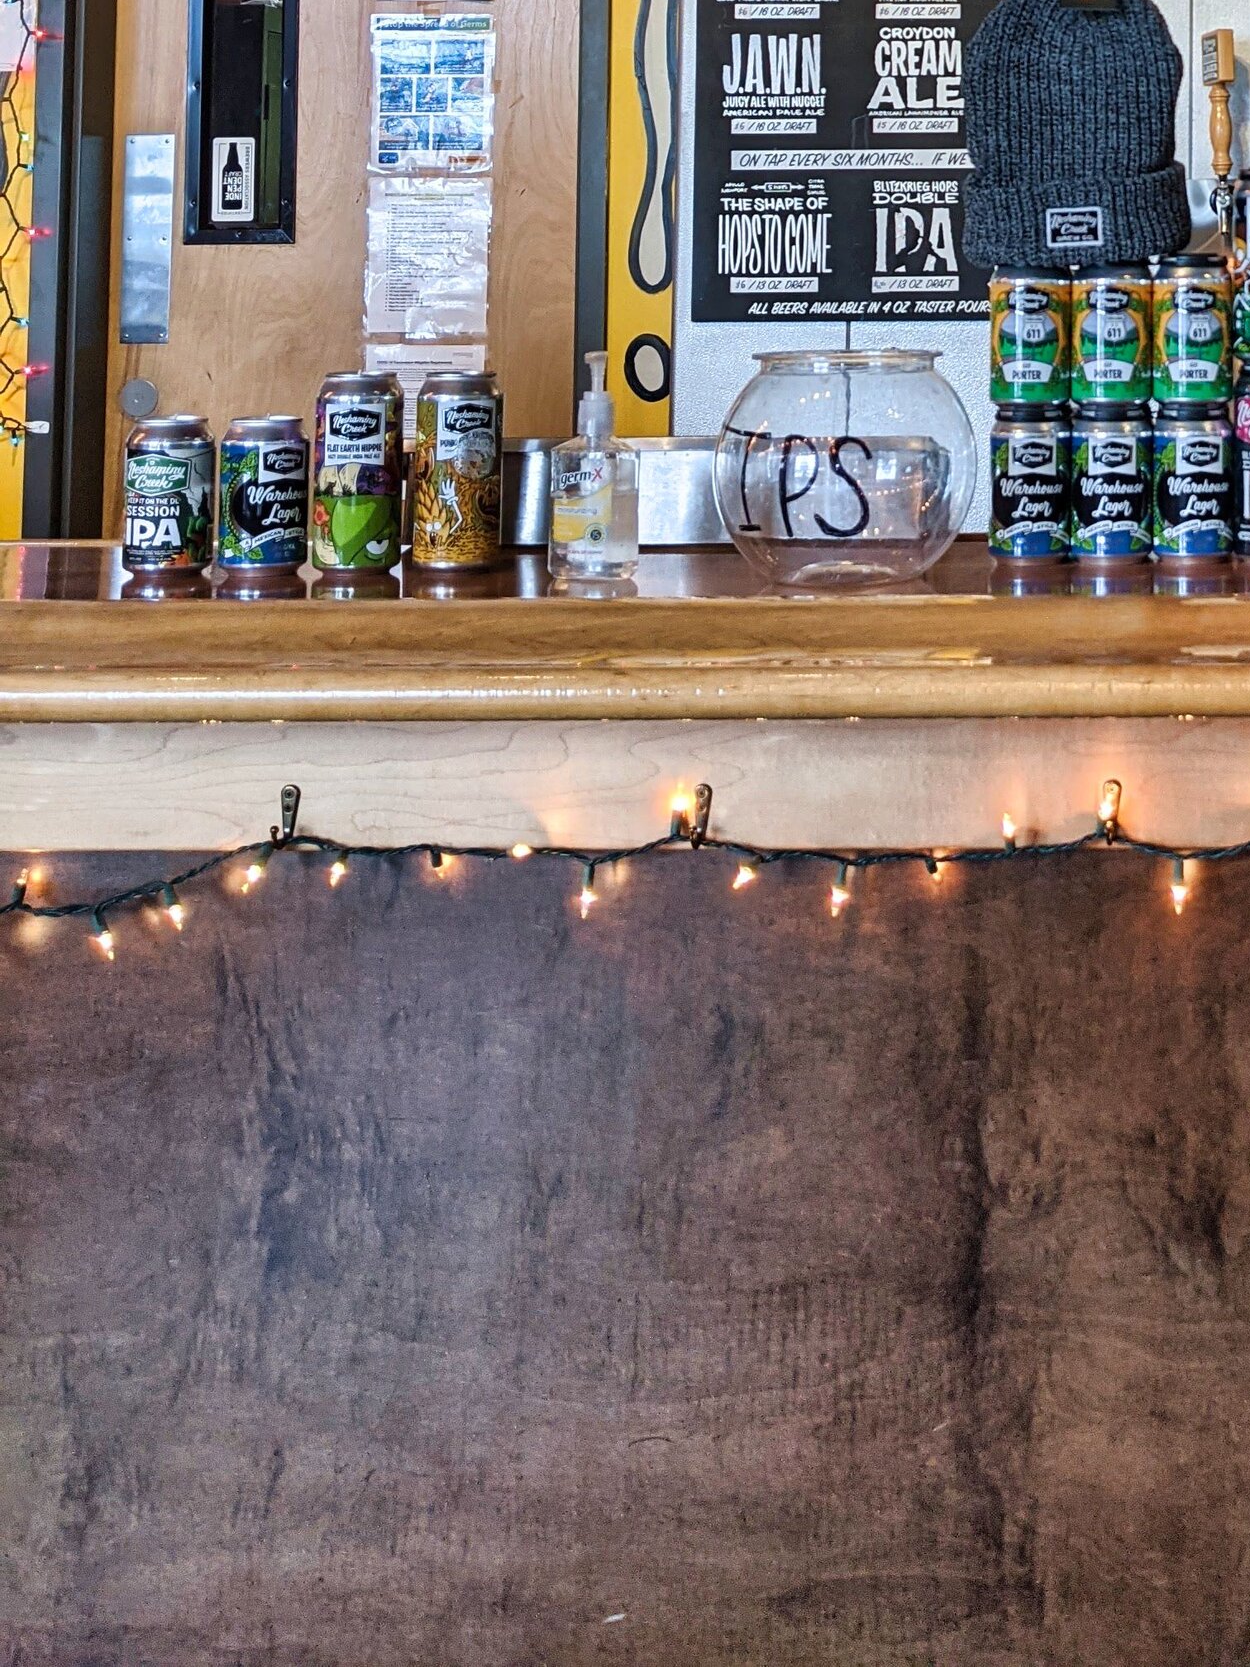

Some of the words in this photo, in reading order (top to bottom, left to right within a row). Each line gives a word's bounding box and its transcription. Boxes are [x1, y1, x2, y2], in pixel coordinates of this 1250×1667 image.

[463, 20, 487, 28] Germs
[879, 26, 955, 39] CROYDON
[722, 34, 827, 94] J.A.W.N.
[874, 39, 962, 77] CREAM
[867, 76, 965, 109] ALE
[722, 96, 749, 109] JUICY
[750, 96, 767, 108] ALE
[768, 95, 790, 108] WITH
[791, 95, 825, 108] NUGGET
[739, 155, 759, 167] ON
[763, 154, 787, 166] TAP
[788, 154, 829, 167] EVERY
[831, 154, 854, 166] SIX
[931, 153, 942, 164] IF
[223, 177, 242, 185] DENT
[226, 185, 242, 193] PEN
[873, 181, 931, 192] BLITZKRIEG
[932, 181, 959, 192] HOPS
[224, 193, 242, 201] INDE
[720, 197, 753, 211] THE
[753, 197, 804, 211] SHAPE
[806, 197, 829, 210] OF
[872, 193, 959, 204] DOUBLE
[717, 214, 761, 274] HOPS
[761, 214, 781, 274] TO
[784, 214, 833, 274] COME
[874, 208, 959, 272] IPA
[748, 301, 768, 315] ALL
[771, 300, 808, 314] BEERS
[809, 300, 865, 314] AVAILABLE
[867, 300, 880, 313] IN
[882, 300, 891, 313] 4
[893, 300, 909, 313] OZ
[913, 299, 954, 313] TASTER
[1026, 328, 1042, 339] 611
[1106, 328, 1122, 339] 611
[340, 444, 360, 452] EARTH
[361, 443, 382, 452] HIPPIE
[128, 461, 186, 481] Neshaminy
[560, 467, 603, 488] germ-X
[134, 474, 173, 489] Creek
[1000, 478, 1063, 497] Warehouse
[1080, 477, 1143, 496] Warehouse
[1167, 476, 1230, 495] Warehouse
[126, 505, 180, 516] SESSION
[1011, 497, 1052, 519] Lager
[1092, 496, 1132, 518] Lager
[1179, 495, 1219, 517] Lager
[261, 504, 302, 526] Lager
[126, 518, 182, 547] IPA
